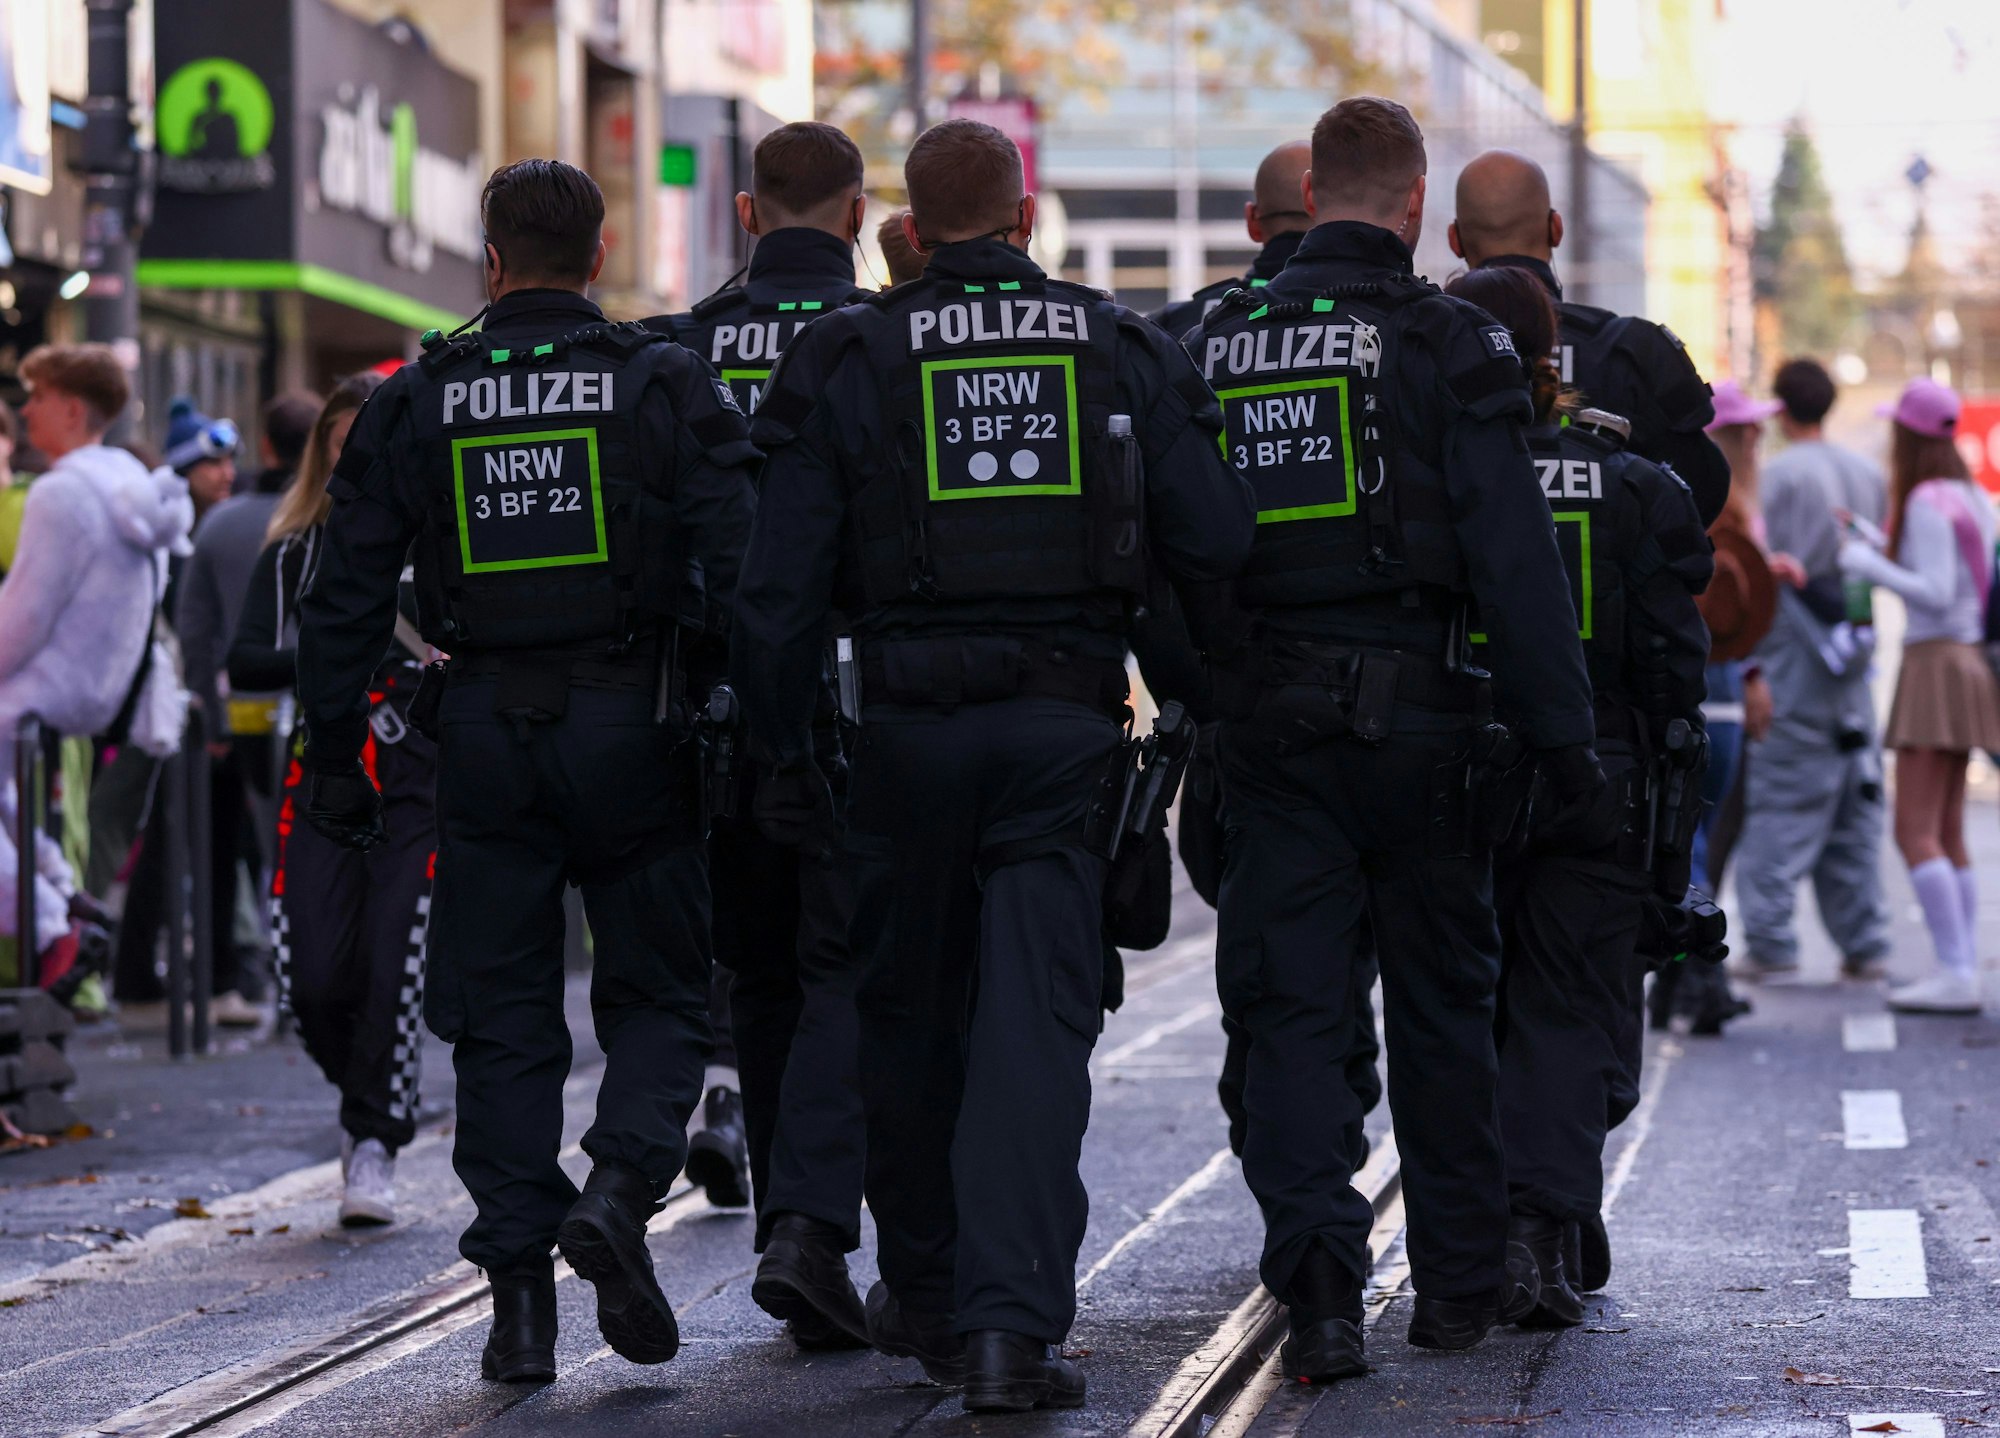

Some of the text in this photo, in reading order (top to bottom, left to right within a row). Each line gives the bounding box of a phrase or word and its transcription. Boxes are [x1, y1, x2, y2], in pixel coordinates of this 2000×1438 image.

[910, 300, 1089, 350] POLIZEI
[443, 372, 613, 424] POLIZEI
[957, 371, 1040, 408] NRW
[945, 414, 1057, 444] 3 BF 22
[1244, 395, 1316, 434] NRW
[484, 446, 563, 484] NRW
[1234, 436, 1332, 469] 3 BF 22
[475, 487, 582, 519] 3 BF 22
